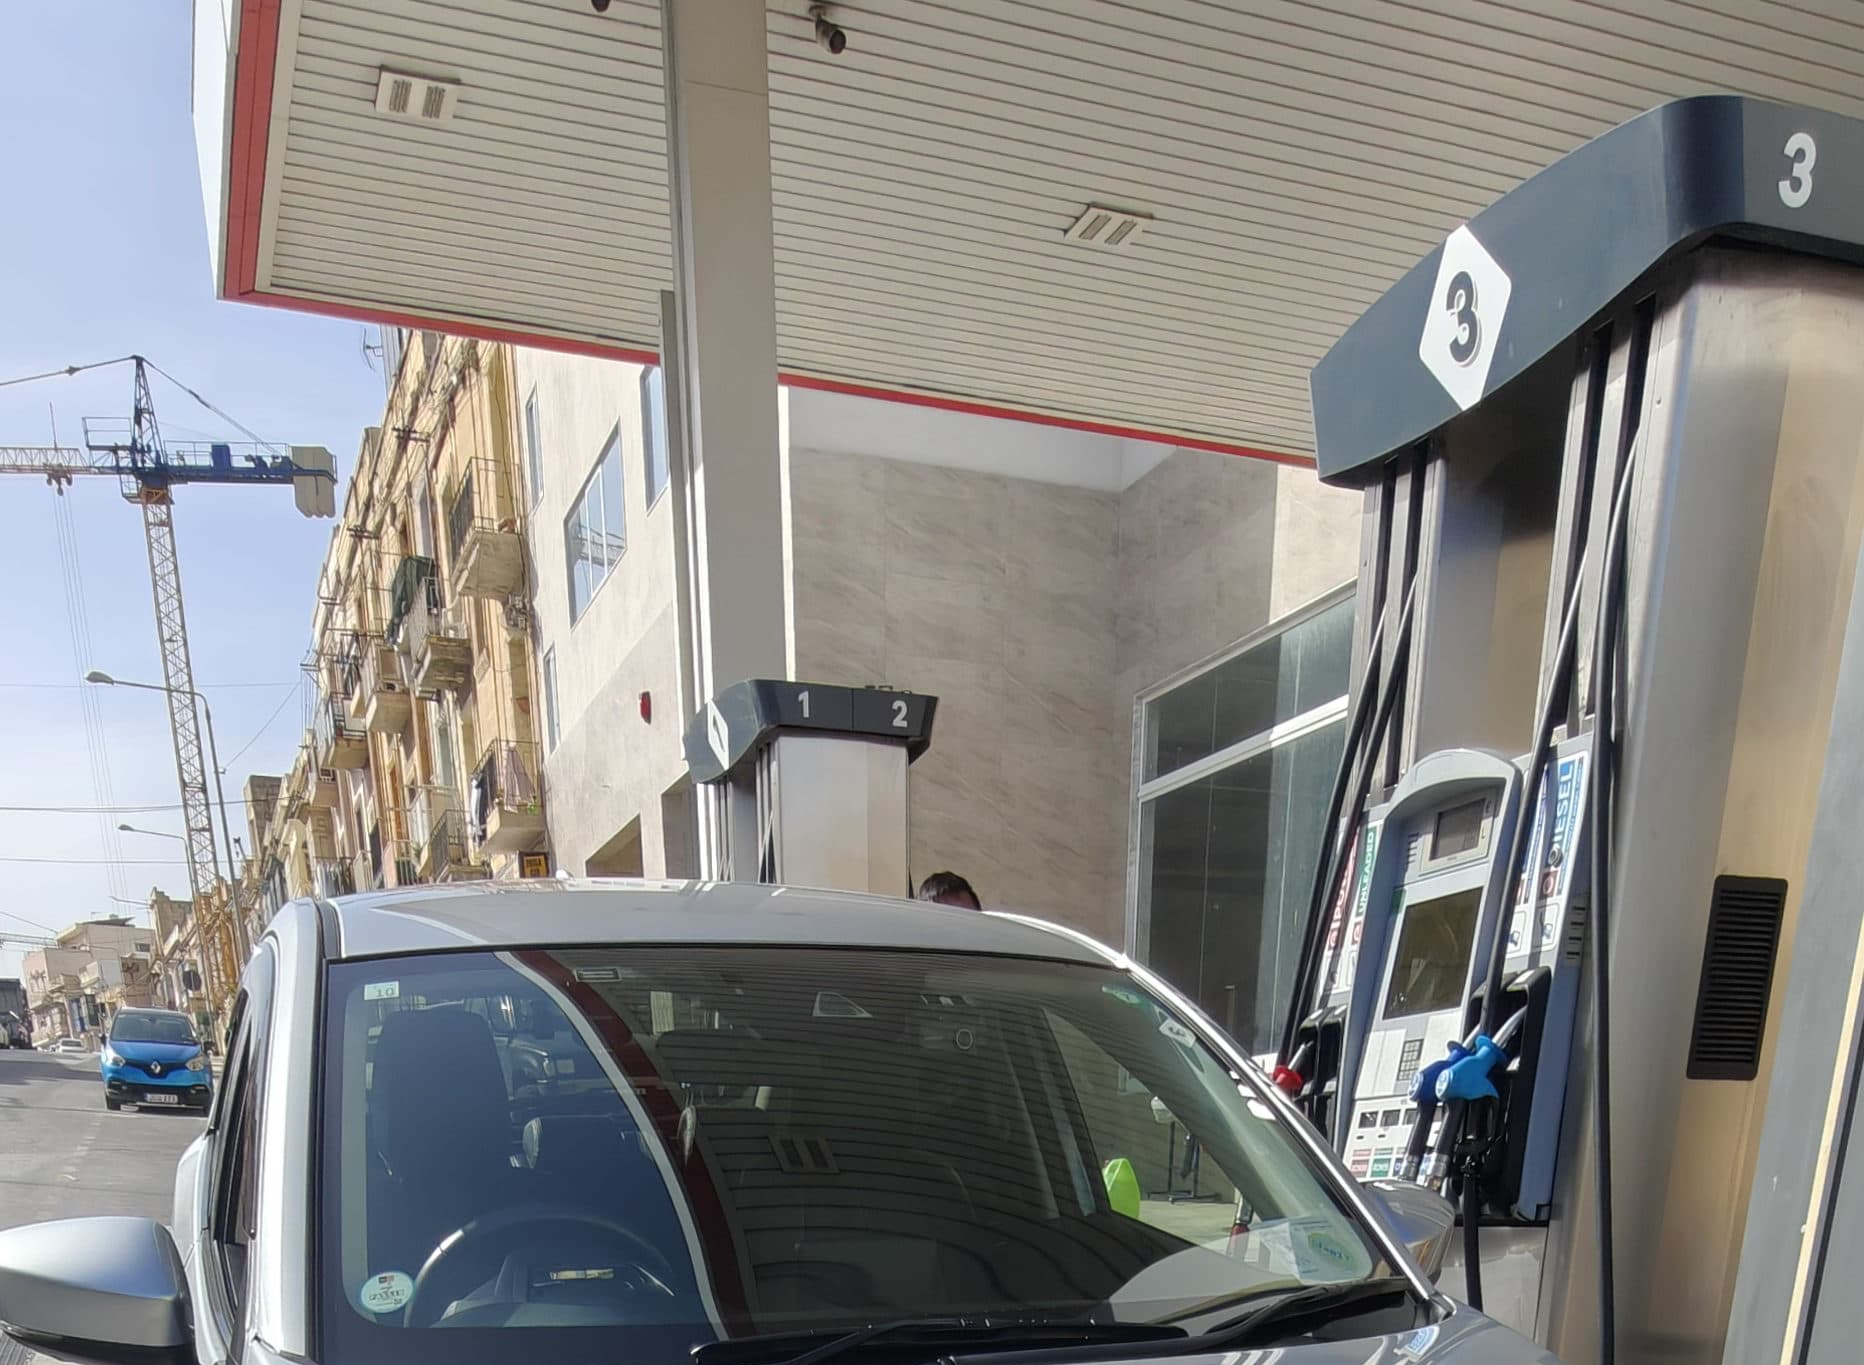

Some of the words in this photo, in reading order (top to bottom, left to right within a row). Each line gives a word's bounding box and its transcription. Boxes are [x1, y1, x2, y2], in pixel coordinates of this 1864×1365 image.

[1778, 131, 1818, 209] 3
[1446, 270, 1483, 367] 3
[798, 690, 810, 718] 1
[892, 700, 908, 728] 2
[1359, 831, 1375, 914] UNLEADED
